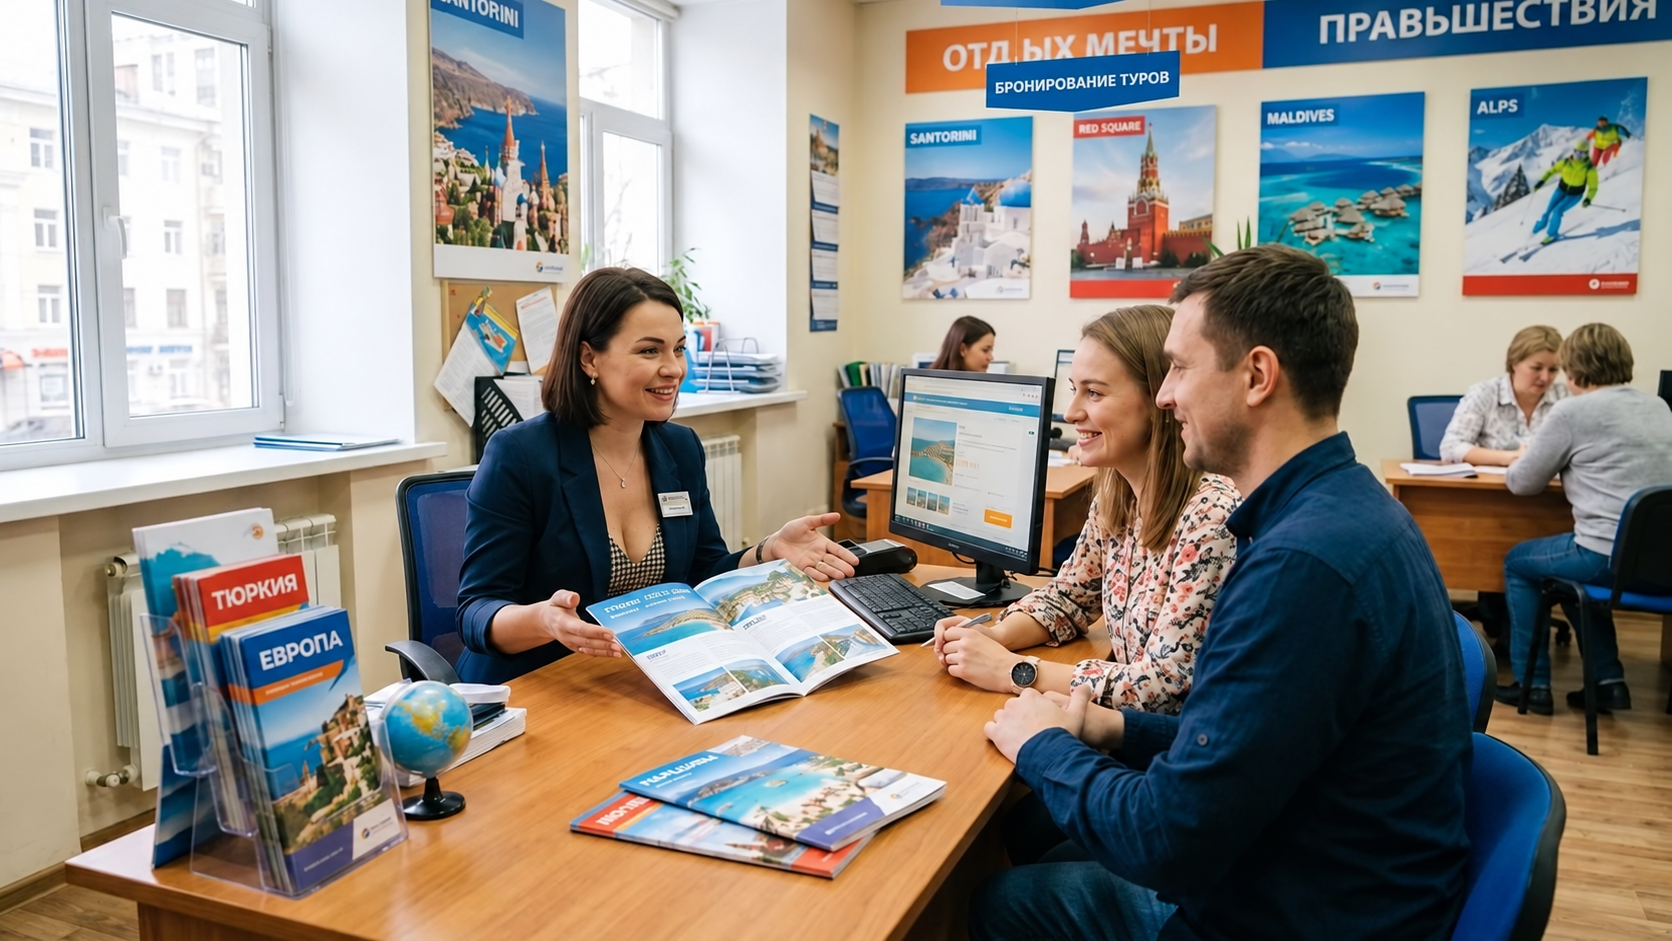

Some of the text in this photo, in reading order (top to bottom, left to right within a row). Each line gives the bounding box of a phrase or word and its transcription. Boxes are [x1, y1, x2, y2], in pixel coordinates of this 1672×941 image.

[440, 0, 519, 28] NTORINI
[1085, 23, 1217, 57] МЕЧТЫ
[995, 71, 1170, 94] БРОНИРОВАНИЕ ТУРОВ
[1267, 108, 1335, 125] MALDIVES
[1477, 98, 1518, 115] ALPS
[910, 129, 977, 145] SANTORINI
[1079, 121, 1141, 134] RED SQUARE
[211, 573, 298, 610] ТЮРКИЯ
[259, 630, 343, 671] ЕВРОПА
